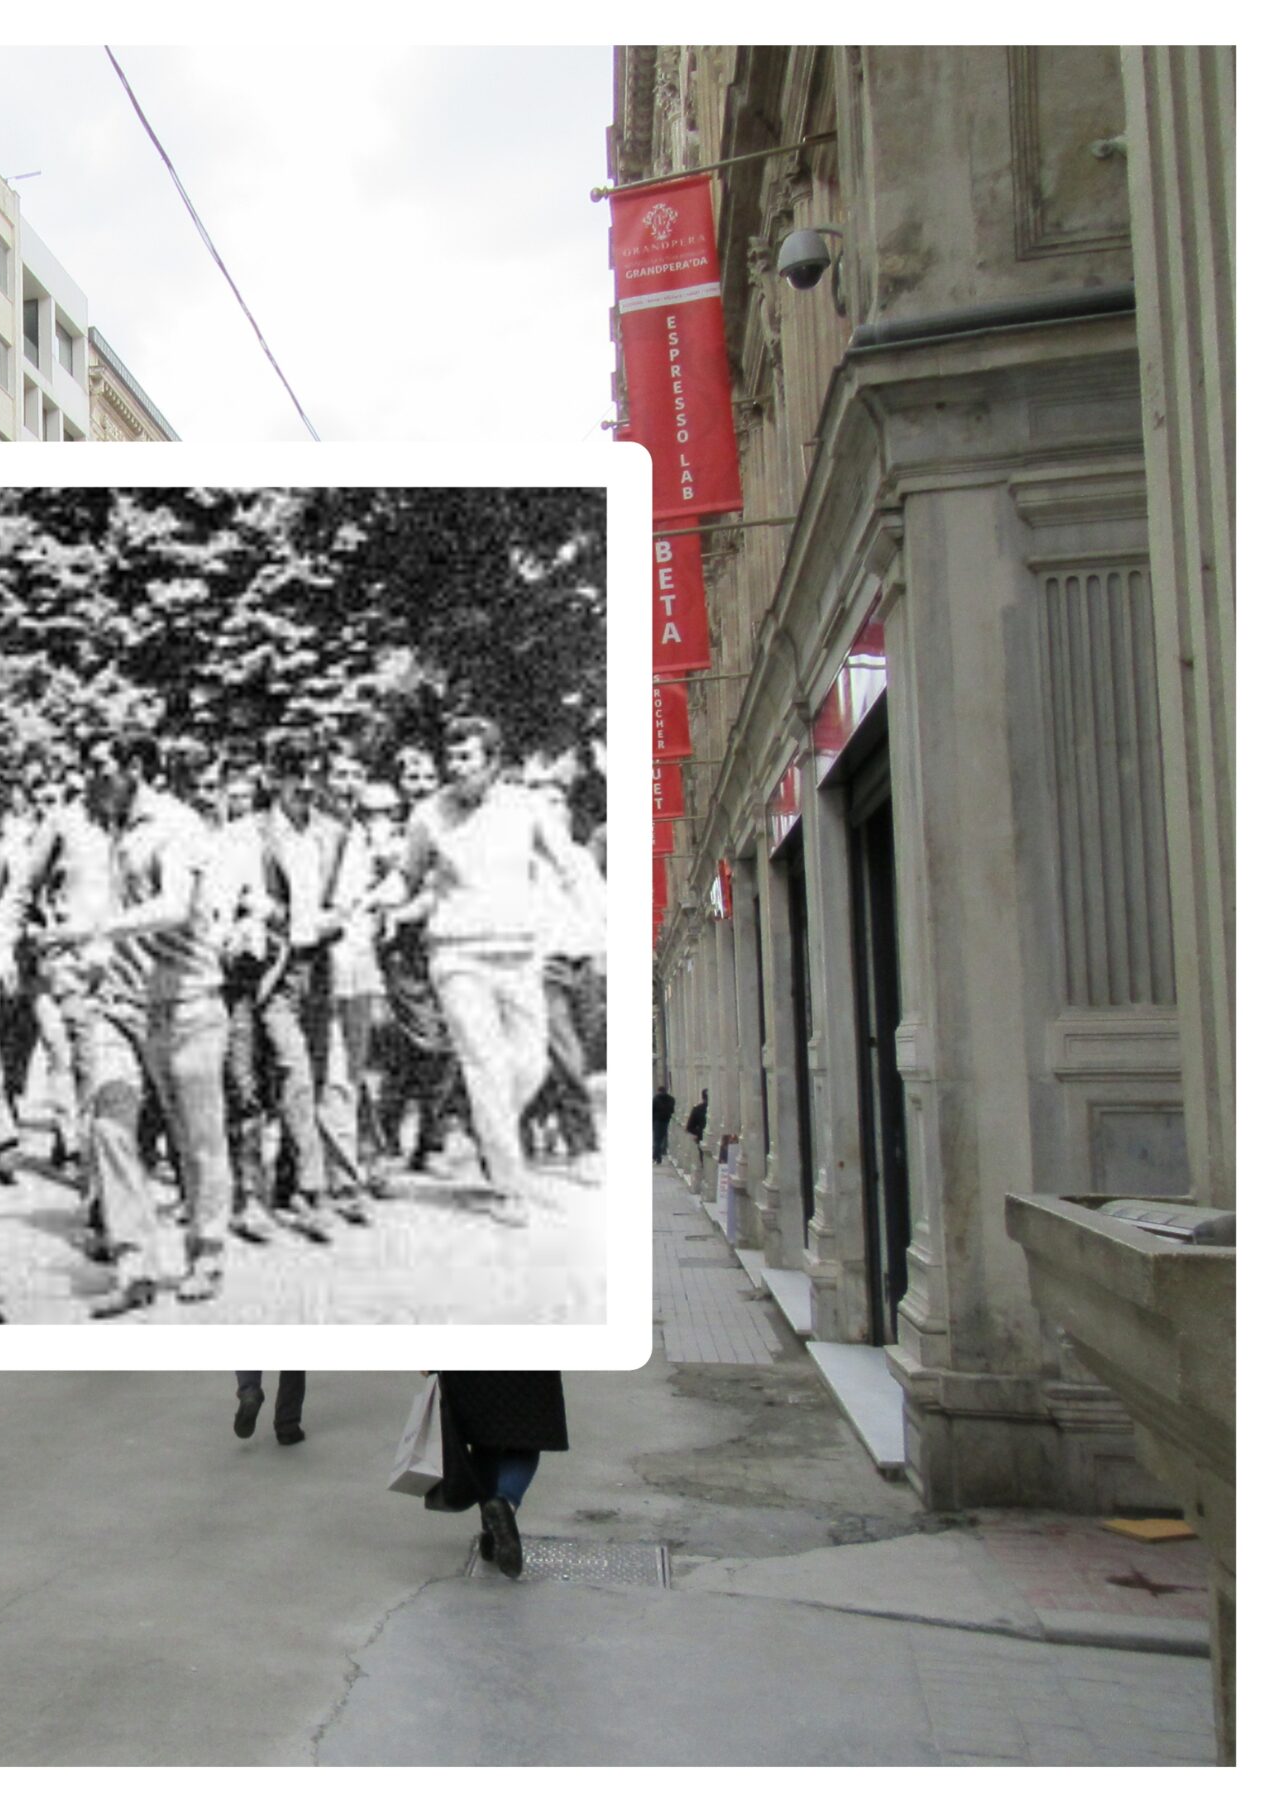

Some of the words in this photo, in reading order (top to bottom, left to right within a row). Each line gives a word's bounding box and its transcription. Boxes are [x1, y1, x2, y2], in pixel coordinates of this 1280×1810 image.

[623, 234, 706, 257] GRANDPERA
[625, 256, 708, 279] GRANDPERA'DA
[666, 315, 689, 444] ESPRESSO
[680, 453, 695, 501] LAB
[655, 540, 682, 645] BETA
[653, 688, 665, 750] ROCHER
[652, 758, 663, 810] UET
